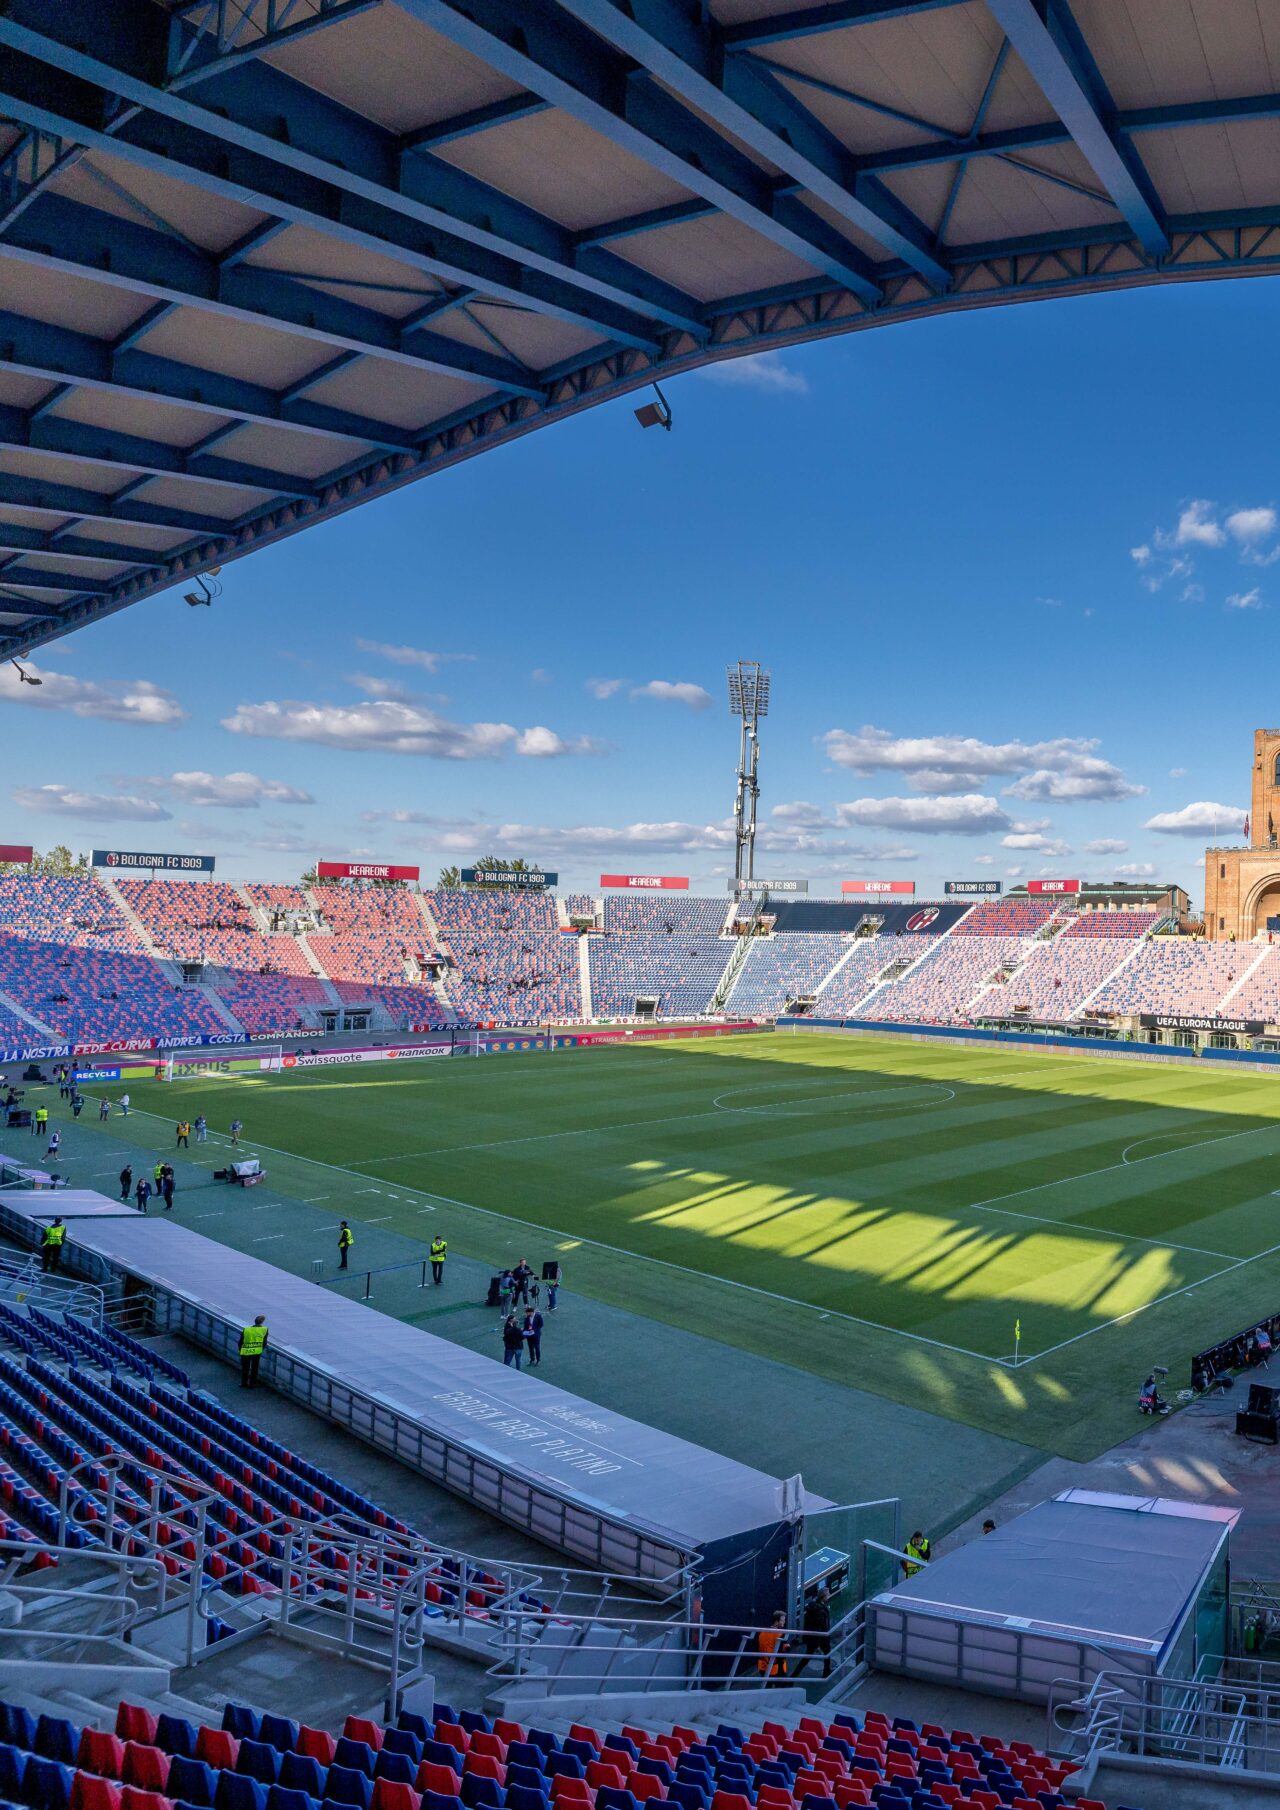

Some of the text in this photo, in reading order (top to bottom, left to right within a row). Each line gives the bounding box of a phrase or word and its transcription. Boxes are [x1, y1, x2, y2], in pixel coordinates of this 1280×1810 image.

[121, 854, 202, 868] BOLOGNA FC 1909
[349, 865, 389, 877] WEAREONE
[485, 873, 545, 883] BOLOGNA FC 1909
[629, 877, 662, 886] WEAREONE
[865, 883, 892, 892] WEAREONE
[957, 883, 996, 892] BOLOGNA FC 1909
[1042, 882, 1064, 891] WEAREONE
[1157, 1017, 1178, 1026] UEFA
[1180, 1019, 1211, 1028] EUROPA
[157, 1034, 246, 1048] ANDREA COSTA
[250, 1030, 325, 1041] COMMANDOS
[111, 1039, 152, 1050] CURVA
[1, 1046, 69, 1062] LA NOSTRA
[298, 1053, 362, 1066] Swissquote
[76, 1070, 116, 1079] RECYCLE
[433, 1391, 507, 1420] GARDEN
[488, 1419, 548, 1440] AREA
[530, 1439, 622, 1475] PLATINO
